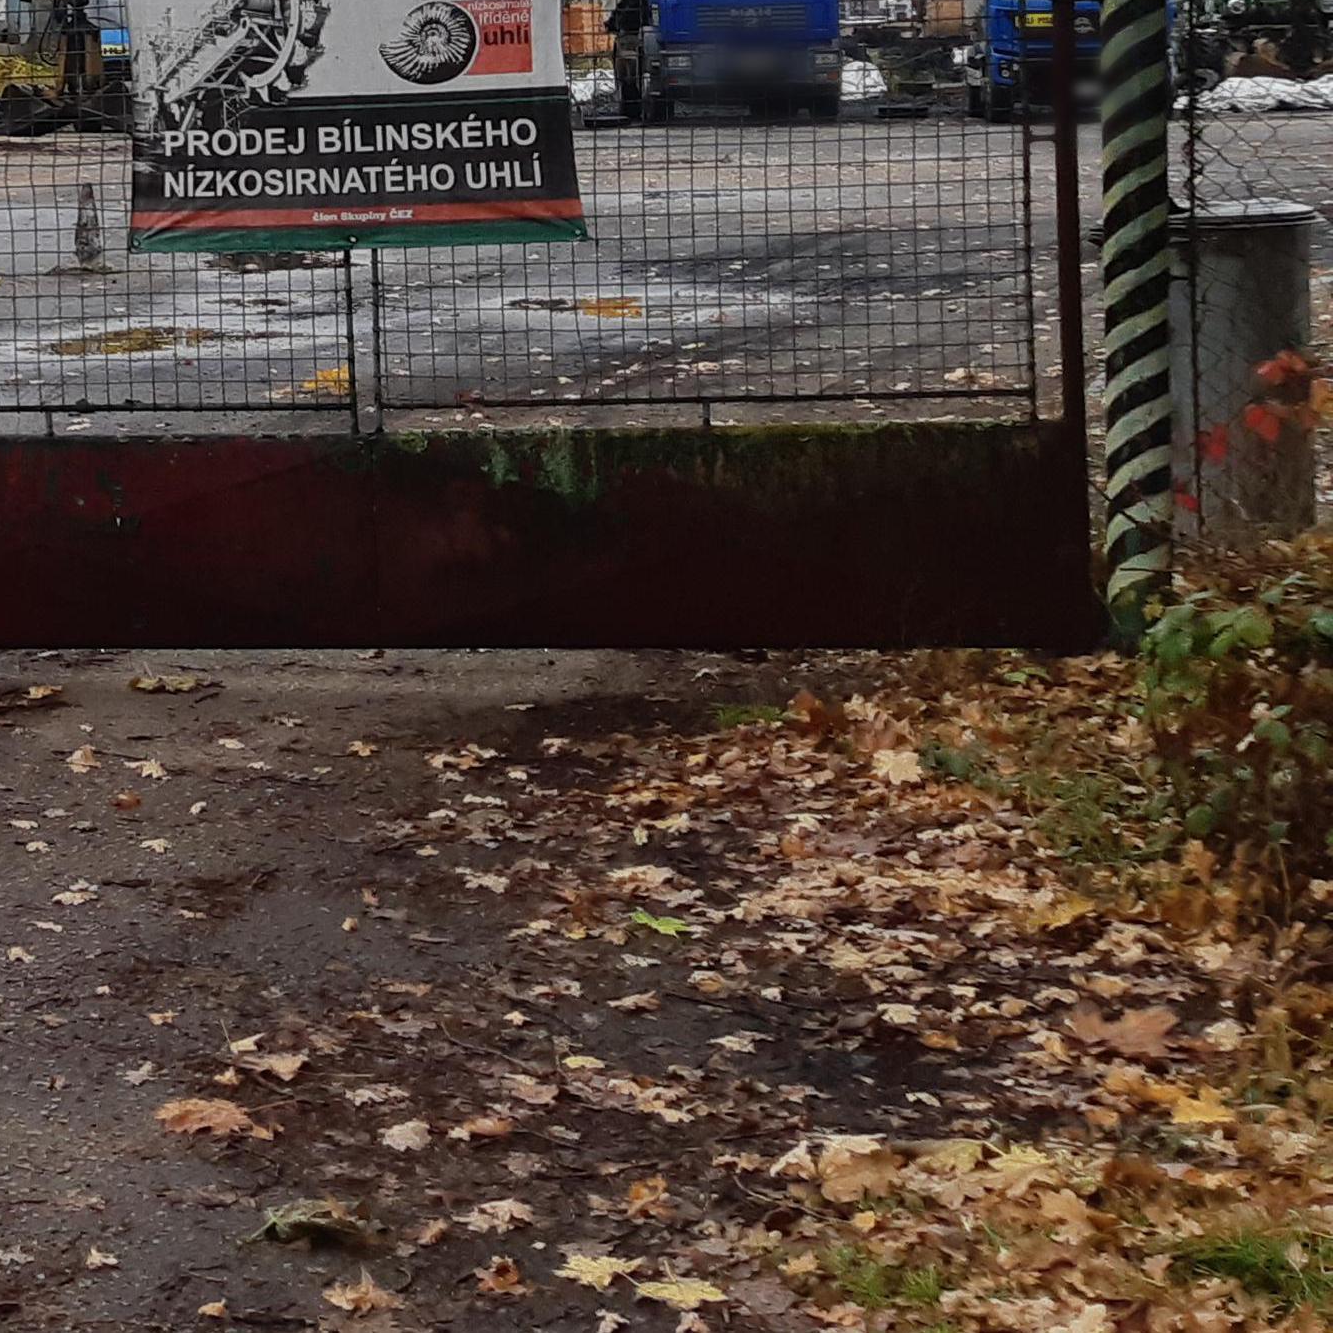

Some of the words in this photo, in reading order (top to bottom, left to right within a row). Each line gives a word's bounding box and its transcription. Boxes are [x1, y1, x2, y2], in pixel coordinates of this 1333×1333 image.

[484, 24, 529, 45] uhlí
[163, 128, 305, 157] PRODEJ
[318, 113, 537, 153] BÍLINSKÉHO
[164, 158, 455, 198] NÍZKOSIRNATÉHO
[465, 152, 542, 189] UHLÍ
[389, 208, 413, 219] ČEZ
